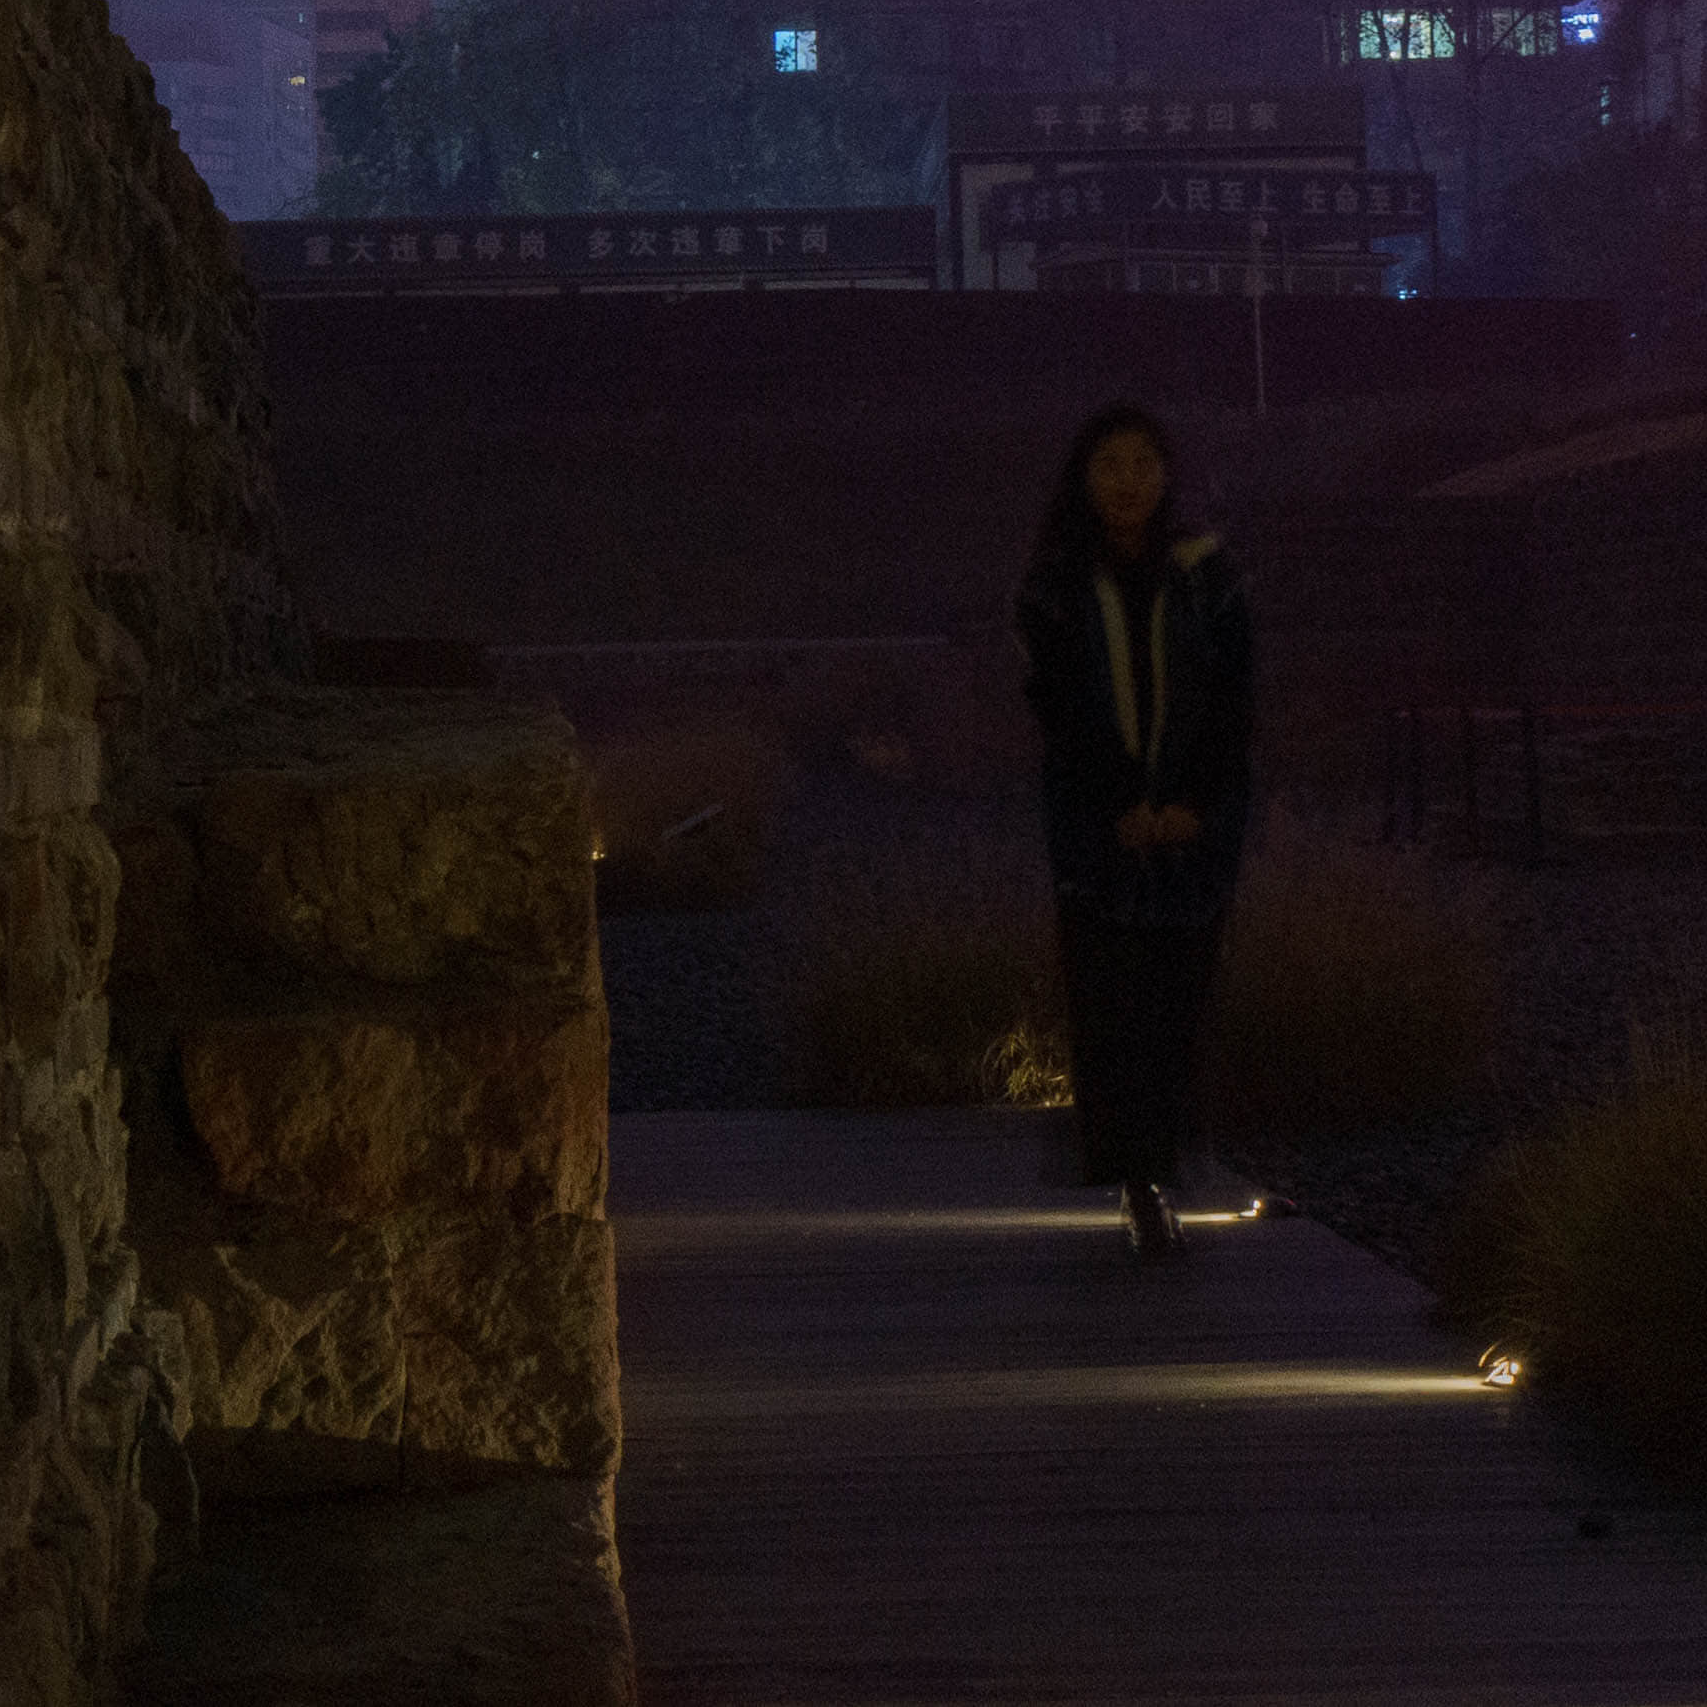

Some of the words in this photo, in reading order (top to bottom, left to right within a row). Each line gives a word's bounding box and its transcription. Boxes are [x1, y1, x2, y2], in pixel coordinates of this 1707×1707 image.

[1032, 101, 1280, 136] 平平安安回家
[1151, 179, 1279, 213] 人民至上
[1301, 180, 1426, 215] 生命至上
[304, 229, 547, 266] 重大违章停岗
[587, 224, 829, 259] 多次违章下岗
